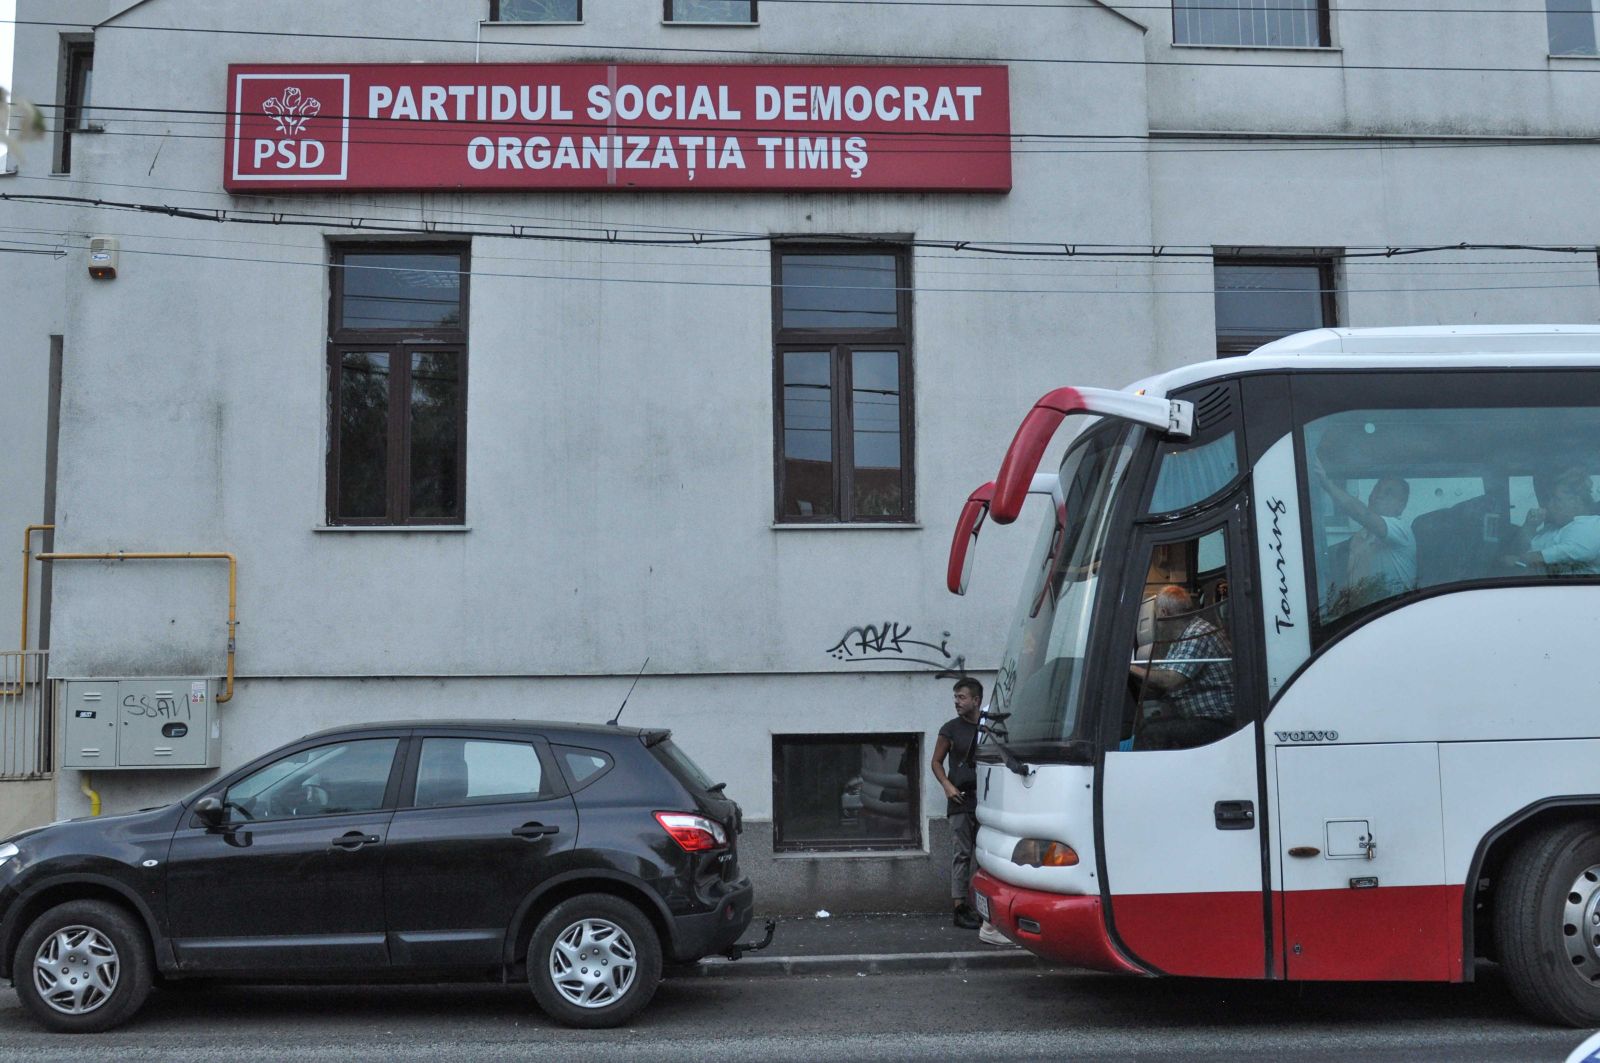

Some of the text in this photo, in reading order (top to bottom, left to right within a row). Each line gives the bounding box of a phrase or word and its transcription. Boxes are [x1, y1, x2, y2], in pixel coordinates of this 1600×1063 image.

[368, 84, 982, 122] PARTIDUL SOCIAL DEMOCRAT
[253, 138, 325, 169] PSD
[1266, 496, 1295, 635] Touring
[1274, 730, 1339, 743] VOLVO
